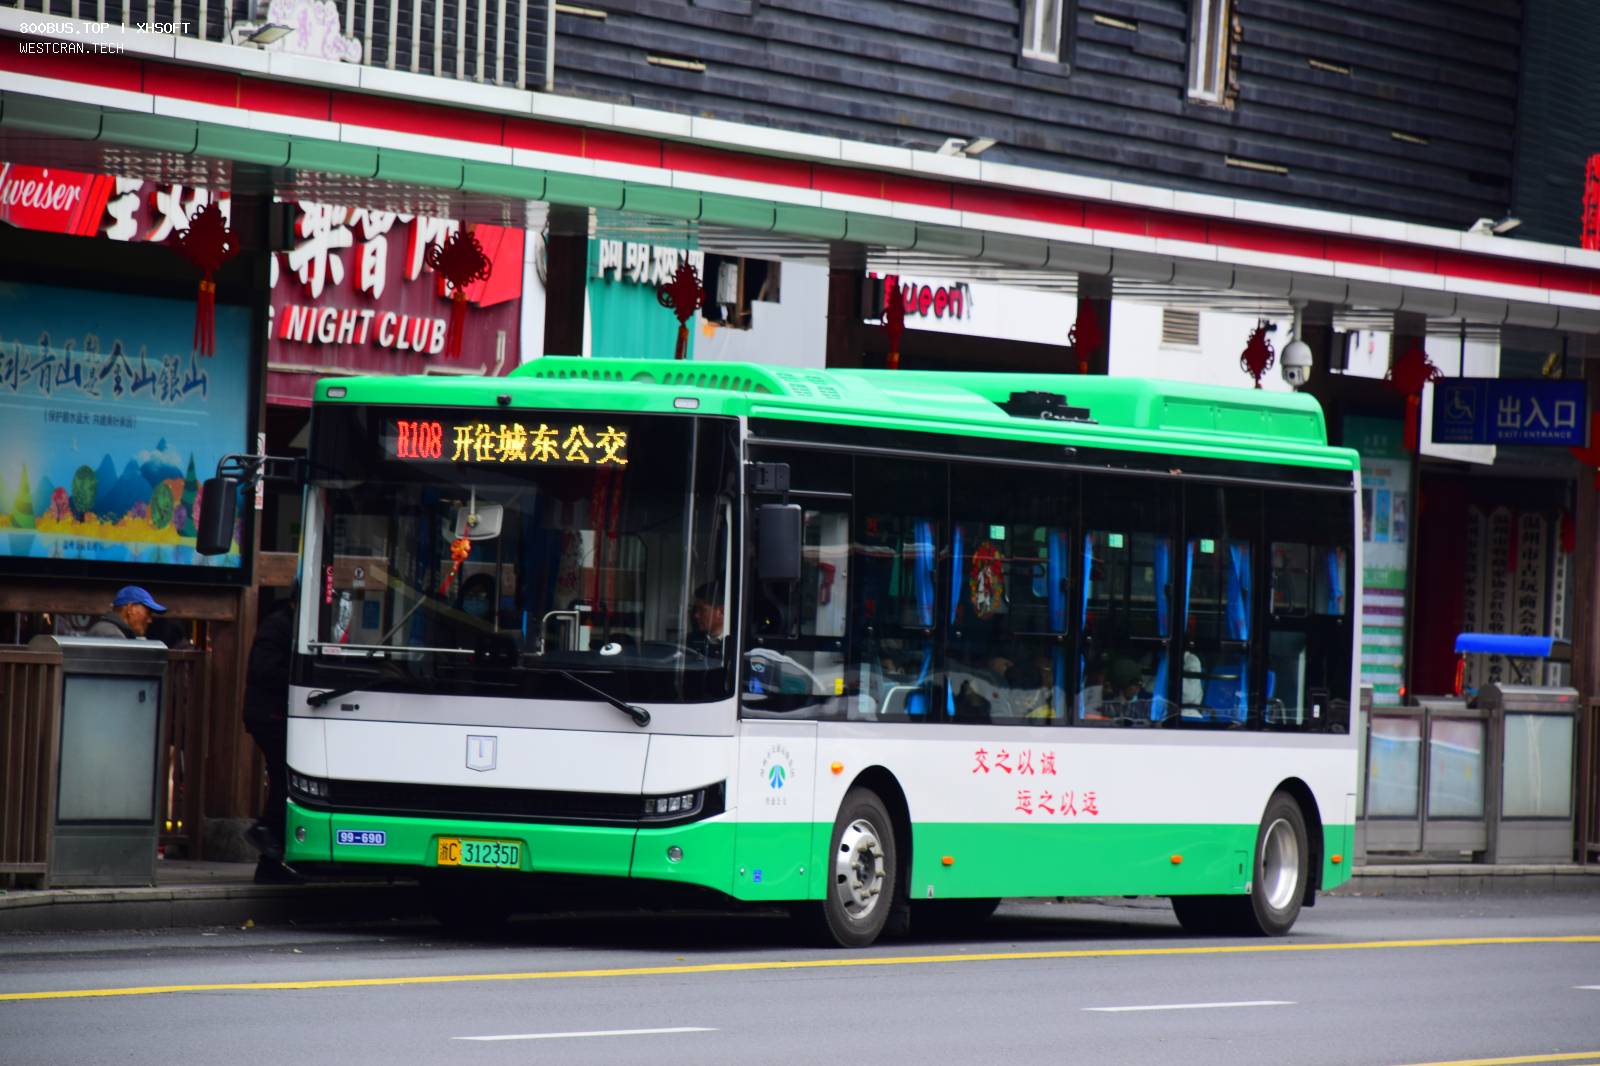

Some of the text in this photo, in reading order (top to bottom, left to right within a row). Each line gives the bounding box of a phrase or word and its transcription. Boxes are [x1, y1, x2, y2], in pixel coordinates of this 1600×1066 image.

[286, 304, 375, 345] NIGHT
[378, 311, 447, 355] CLUB
[1497, 394, 1577, 430] 出入口
[396, 420, 629, 465] B108 开往城东公交
[972, 747, 1057, 776] 交之以诚
[1015, 789, 1099, 816] 运之以远
[340, 831, 383, 844] 99-690
[464, 843, 519, 866] 31235D
